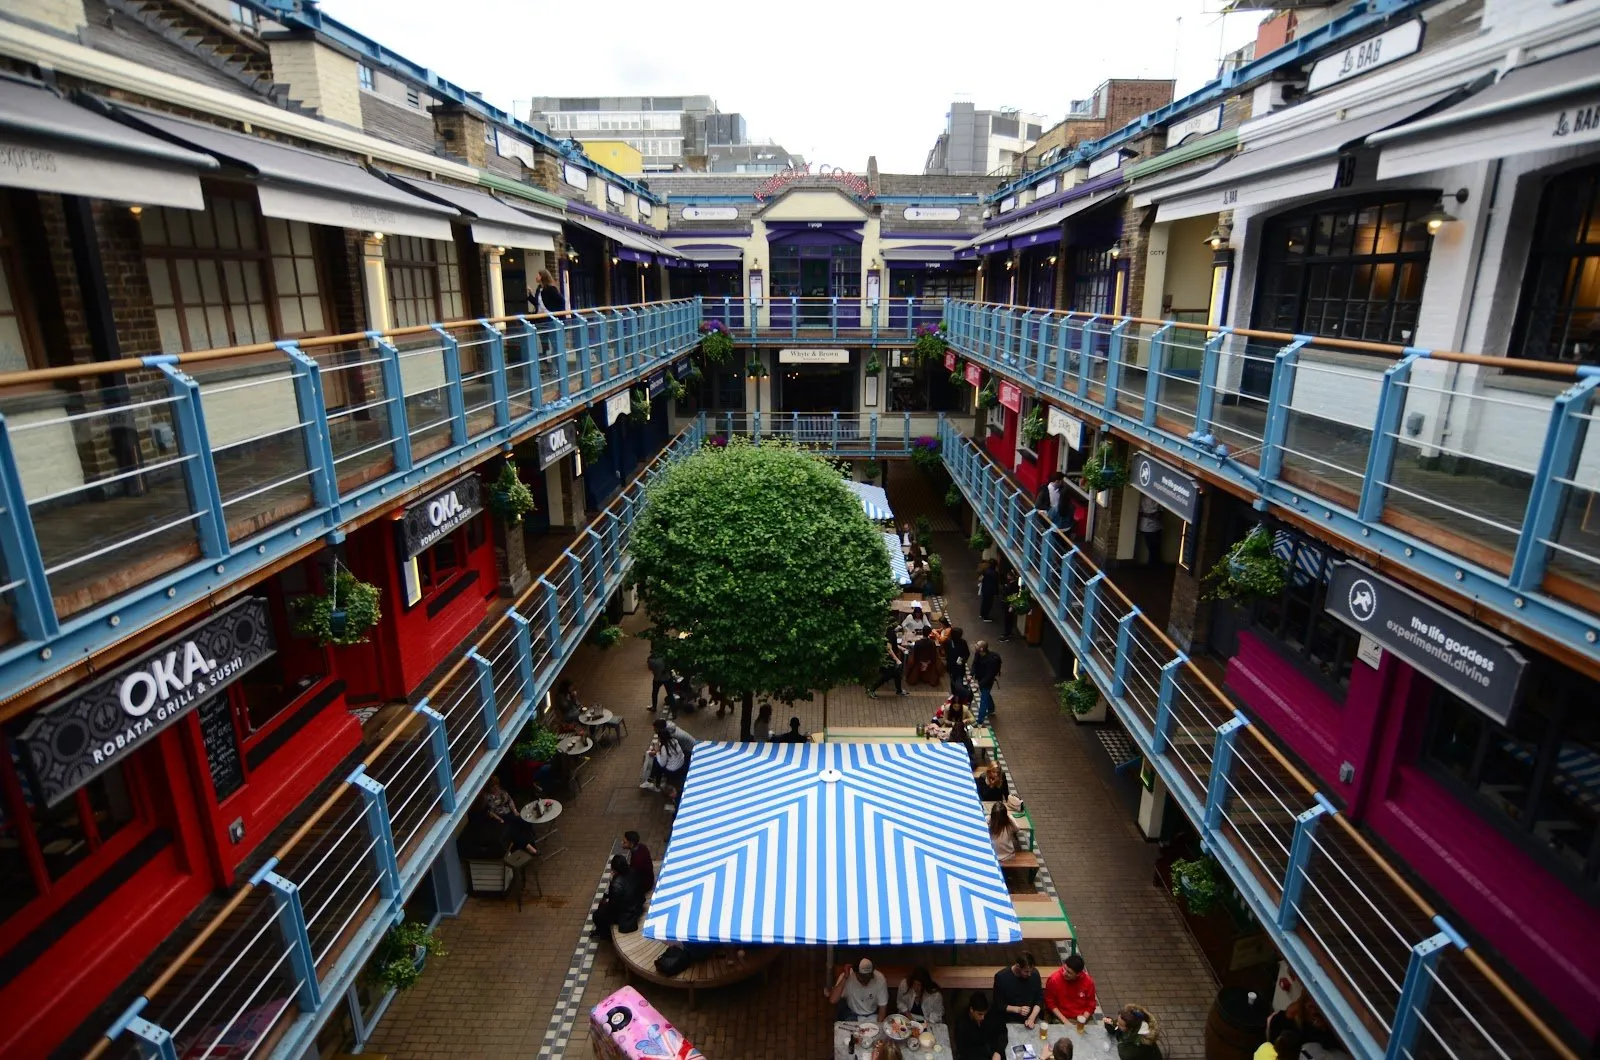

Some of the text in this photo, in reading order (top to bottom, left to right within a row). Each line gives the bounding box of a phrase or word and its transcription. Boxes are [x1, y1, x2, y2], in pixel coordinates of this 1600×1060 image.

[1357, 38, 1383, 69] BAB
[790, 350, 809, 358] Whyte
[420, 528, 441, 547] ROBATA
[440, 520, 455, 533] GRILL
[1386, 619, 1490, 687] experimental.divine
[1410, 615, 1495, 672] the life goddess
[119, 640, 217, 717] OKA.
[92, 656, 244, 764] ROBATA GRILL & SUSHI
